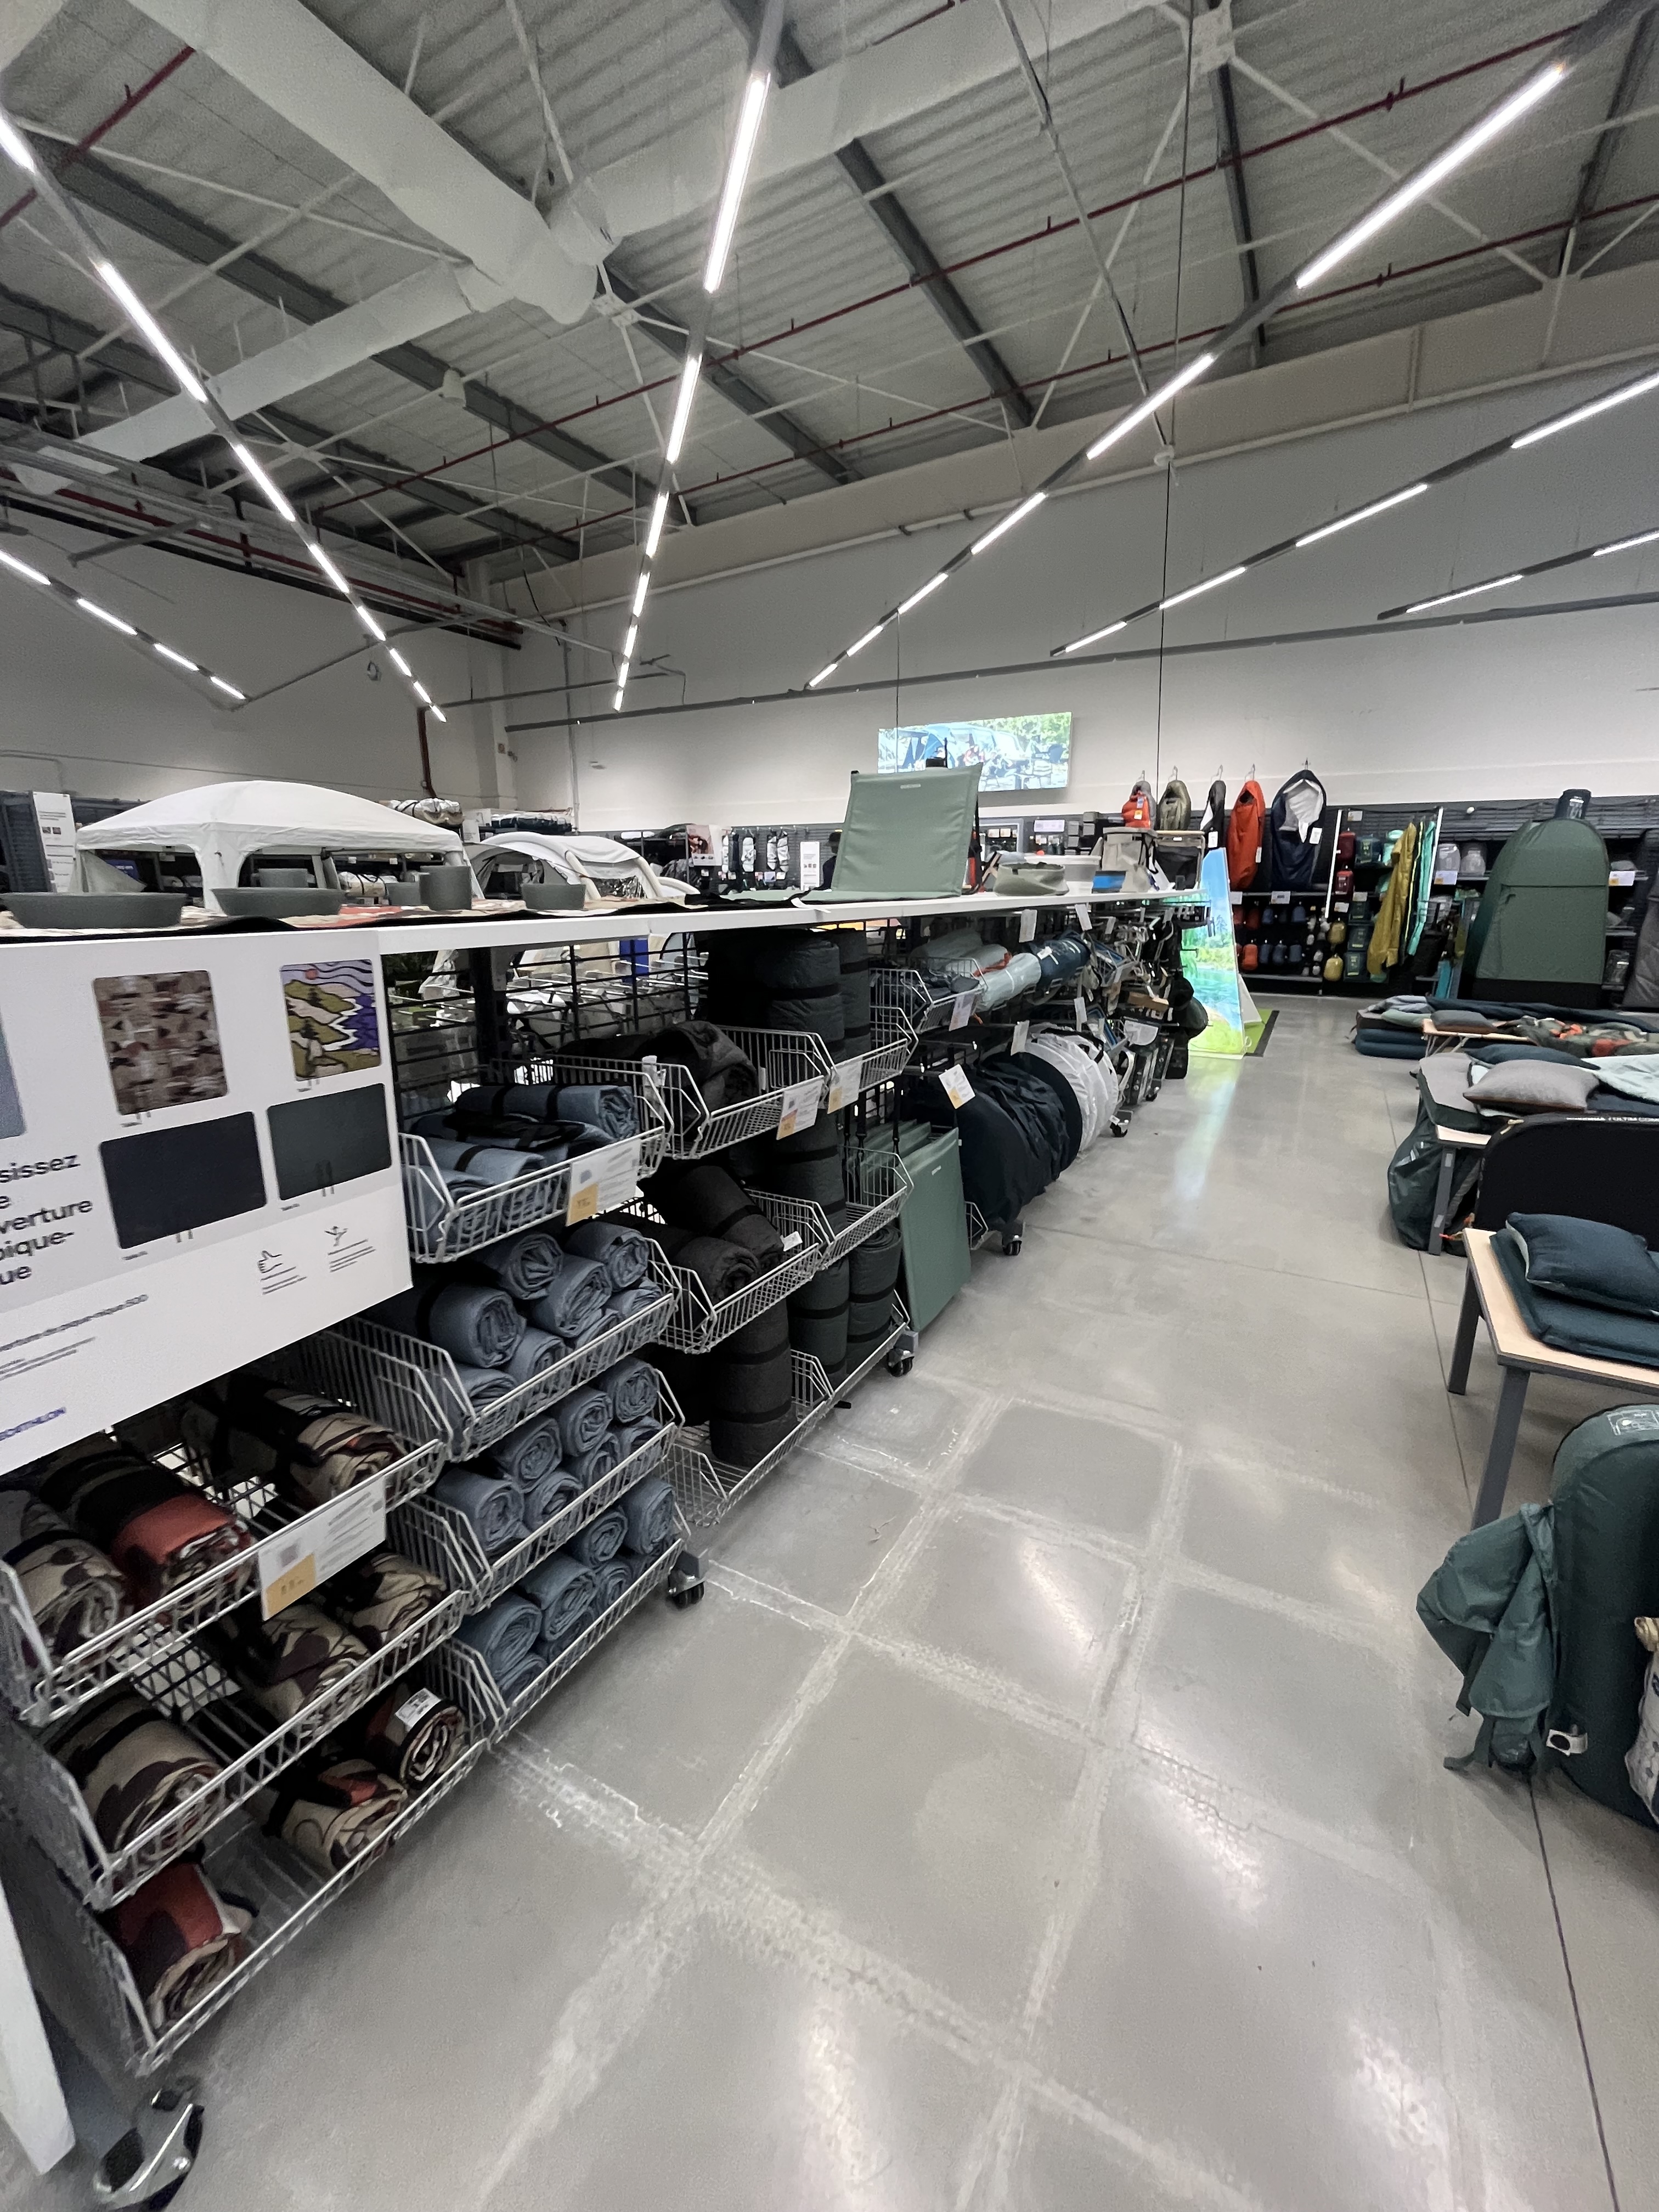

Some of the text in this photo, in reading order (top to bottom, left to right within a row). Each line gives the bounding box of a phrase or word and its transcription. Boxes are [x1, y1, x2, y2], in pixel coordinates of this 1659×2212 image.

[0, 1154, 81, 1183] sissez
[0, 1200, 93, 1234] verture
[0, 1266, 32, 1285] ue
